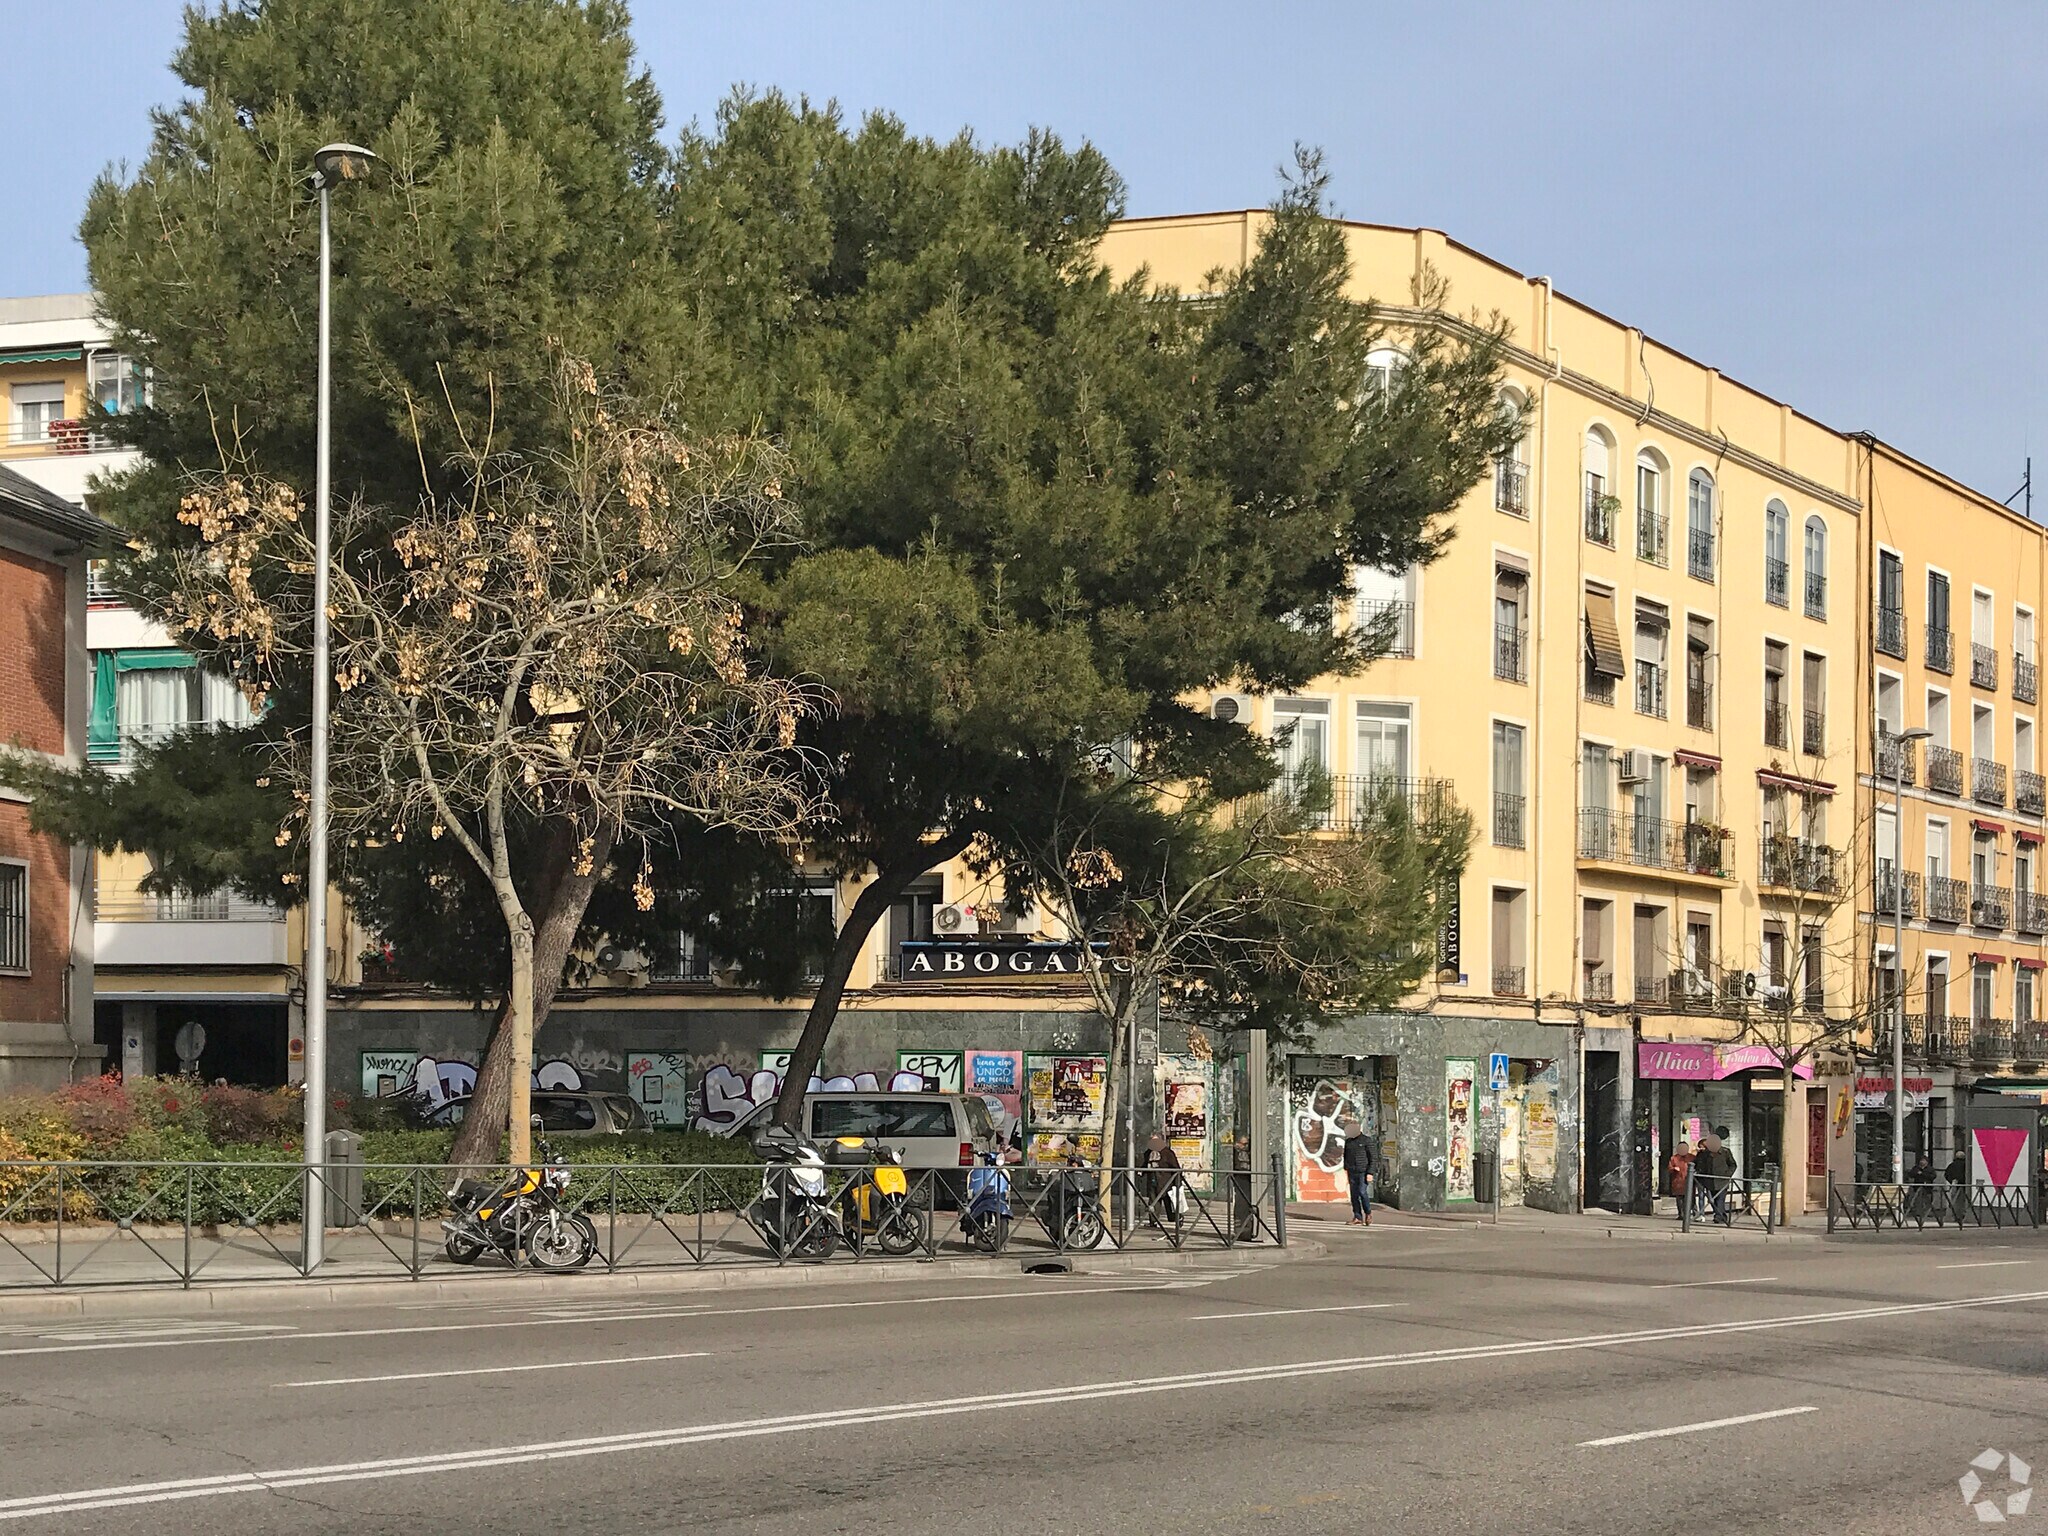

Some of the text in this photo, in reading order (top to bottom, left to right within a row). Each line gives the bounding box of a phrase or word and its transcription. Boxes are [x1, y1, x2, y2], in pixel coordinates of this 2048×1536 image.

[1447, 874, 1458, 965] ABOGAO
[908, 950, 1134, 973] ABOGAO
[976, 1066, 1011, 1076] ÚNICO
[1650, 1050, 1702, 1071] Uñas
